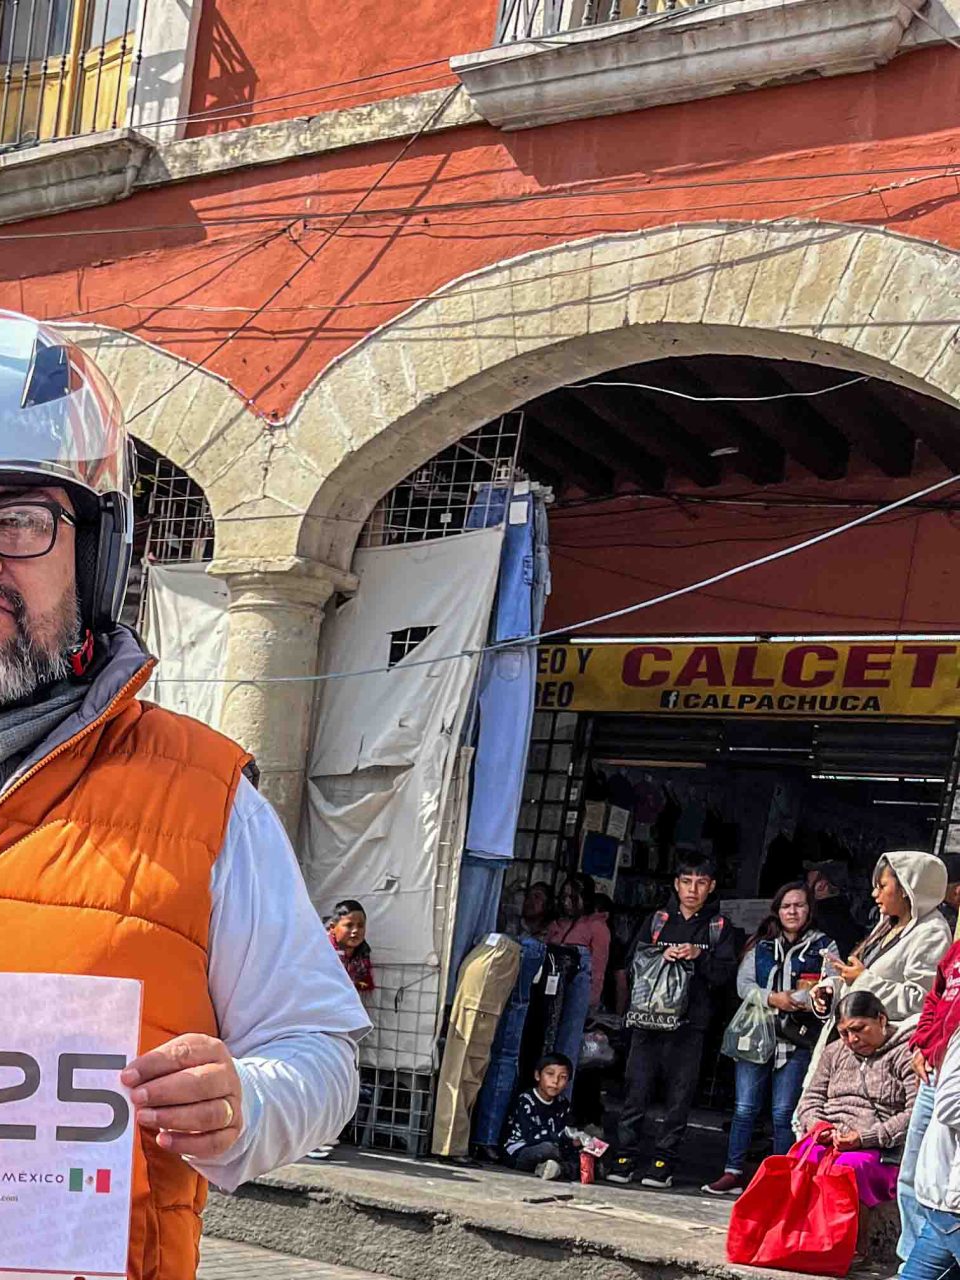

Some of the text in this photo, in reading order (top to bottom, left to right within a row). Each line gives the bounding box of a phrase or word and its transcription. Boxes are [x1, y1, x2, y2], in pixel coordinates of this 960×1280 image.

[577, 648, 593, 674] Y
[621, 645, 960, 688] CALCET
[683, 694, 881, 711] CALPACHUCA
